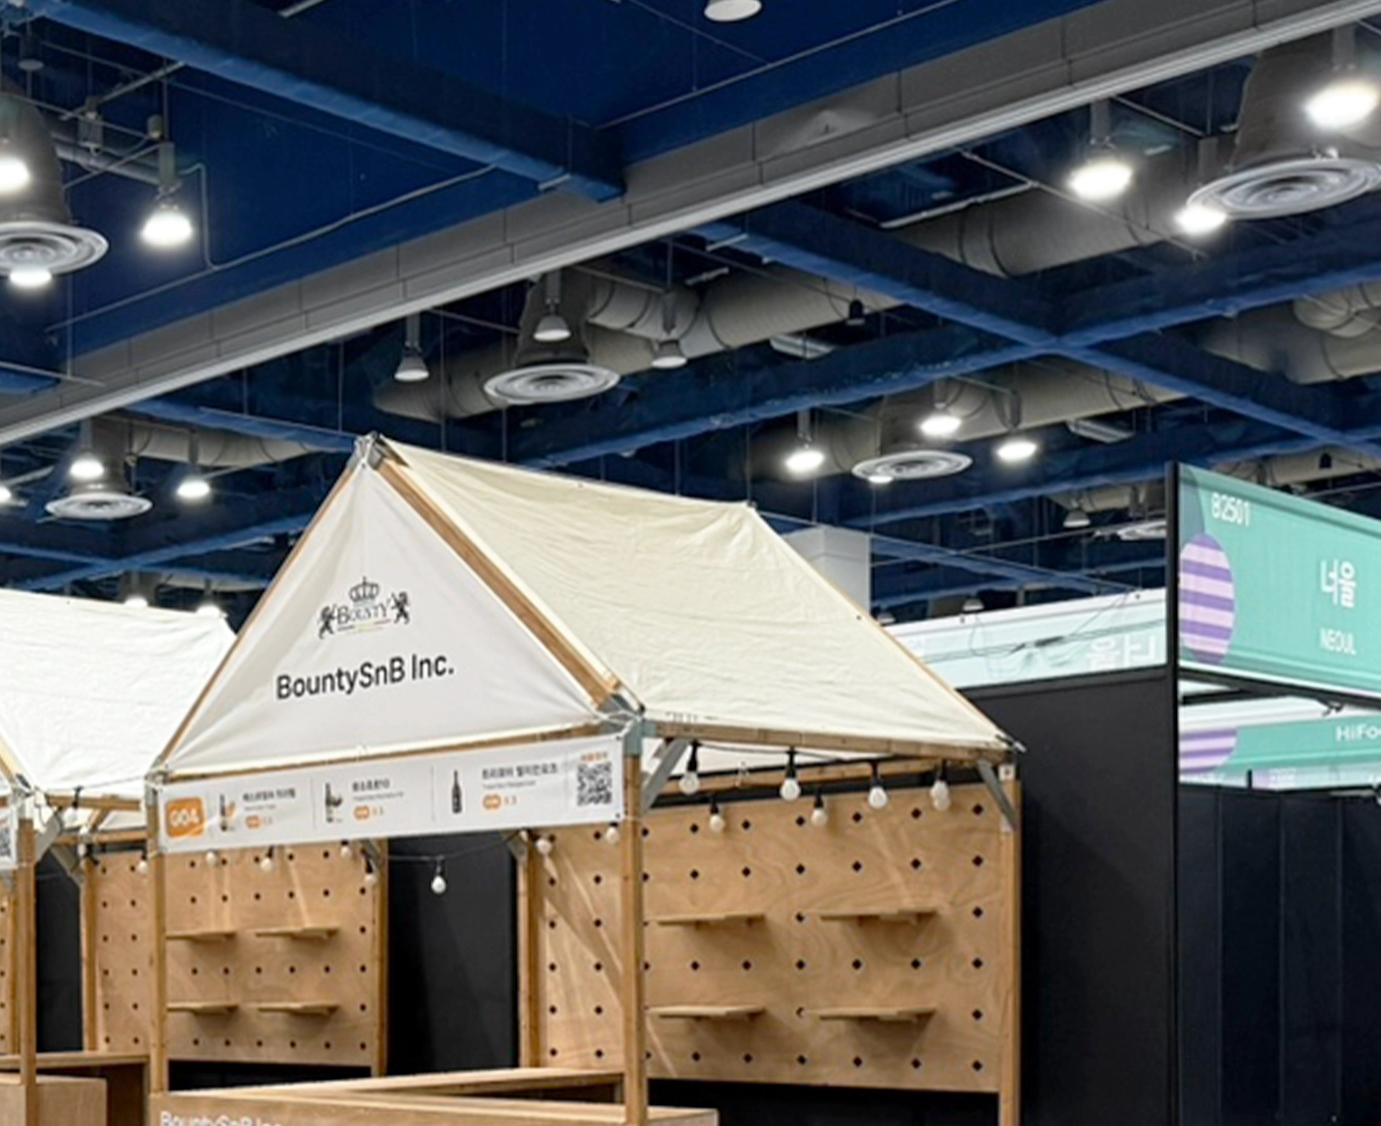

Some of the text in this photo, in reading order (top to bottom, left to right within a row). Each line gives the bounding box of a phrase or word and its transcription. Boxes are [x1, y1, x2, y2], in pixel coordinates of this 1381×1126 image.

[1211, 491, 1250, 527] B2501
[1320, 559, 1357, 608] 너울
[1320, 627, 1357, 656] NEOUL
[277, 654, 455, 700] BountySnB Inc.
